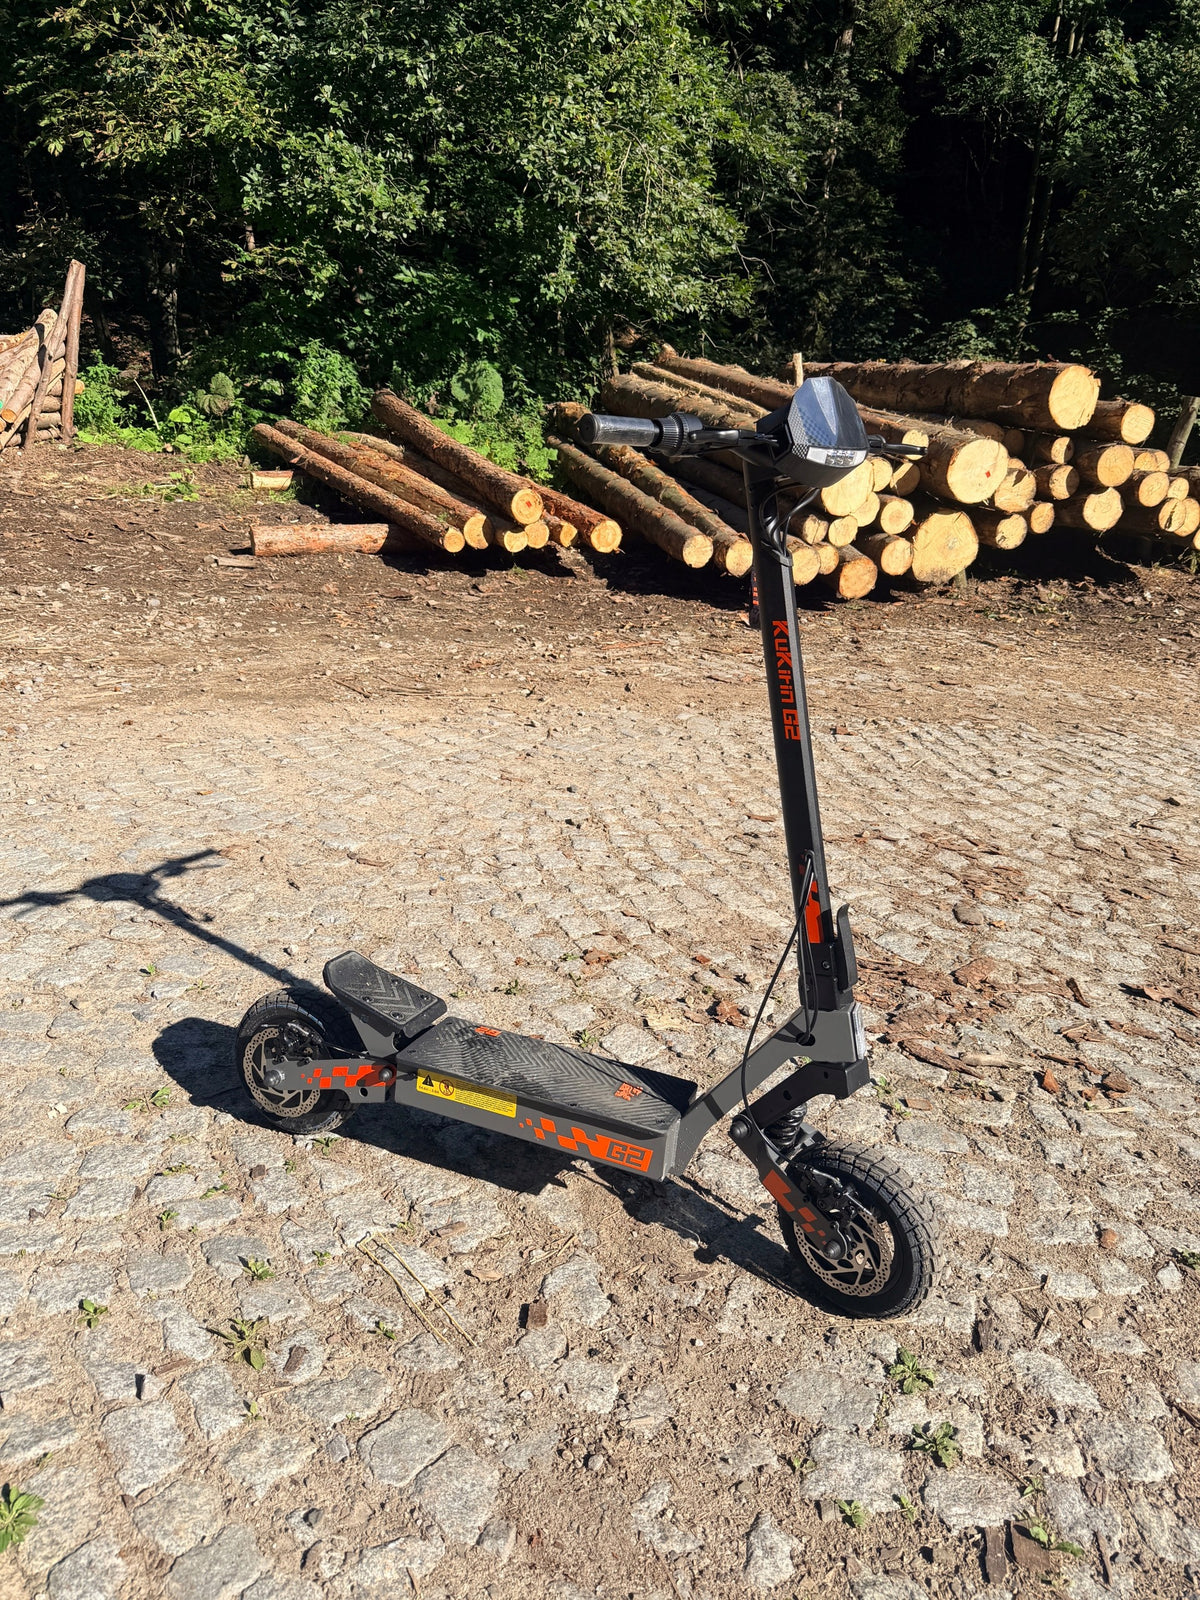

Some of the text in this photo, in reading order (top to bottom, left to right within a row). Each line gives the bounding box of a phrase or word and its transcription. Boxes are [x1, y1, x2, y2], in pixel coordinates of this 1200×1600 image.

[772, 620, 801, 741] KuKirin G2
[605, 1141, 646, 1168] G2
